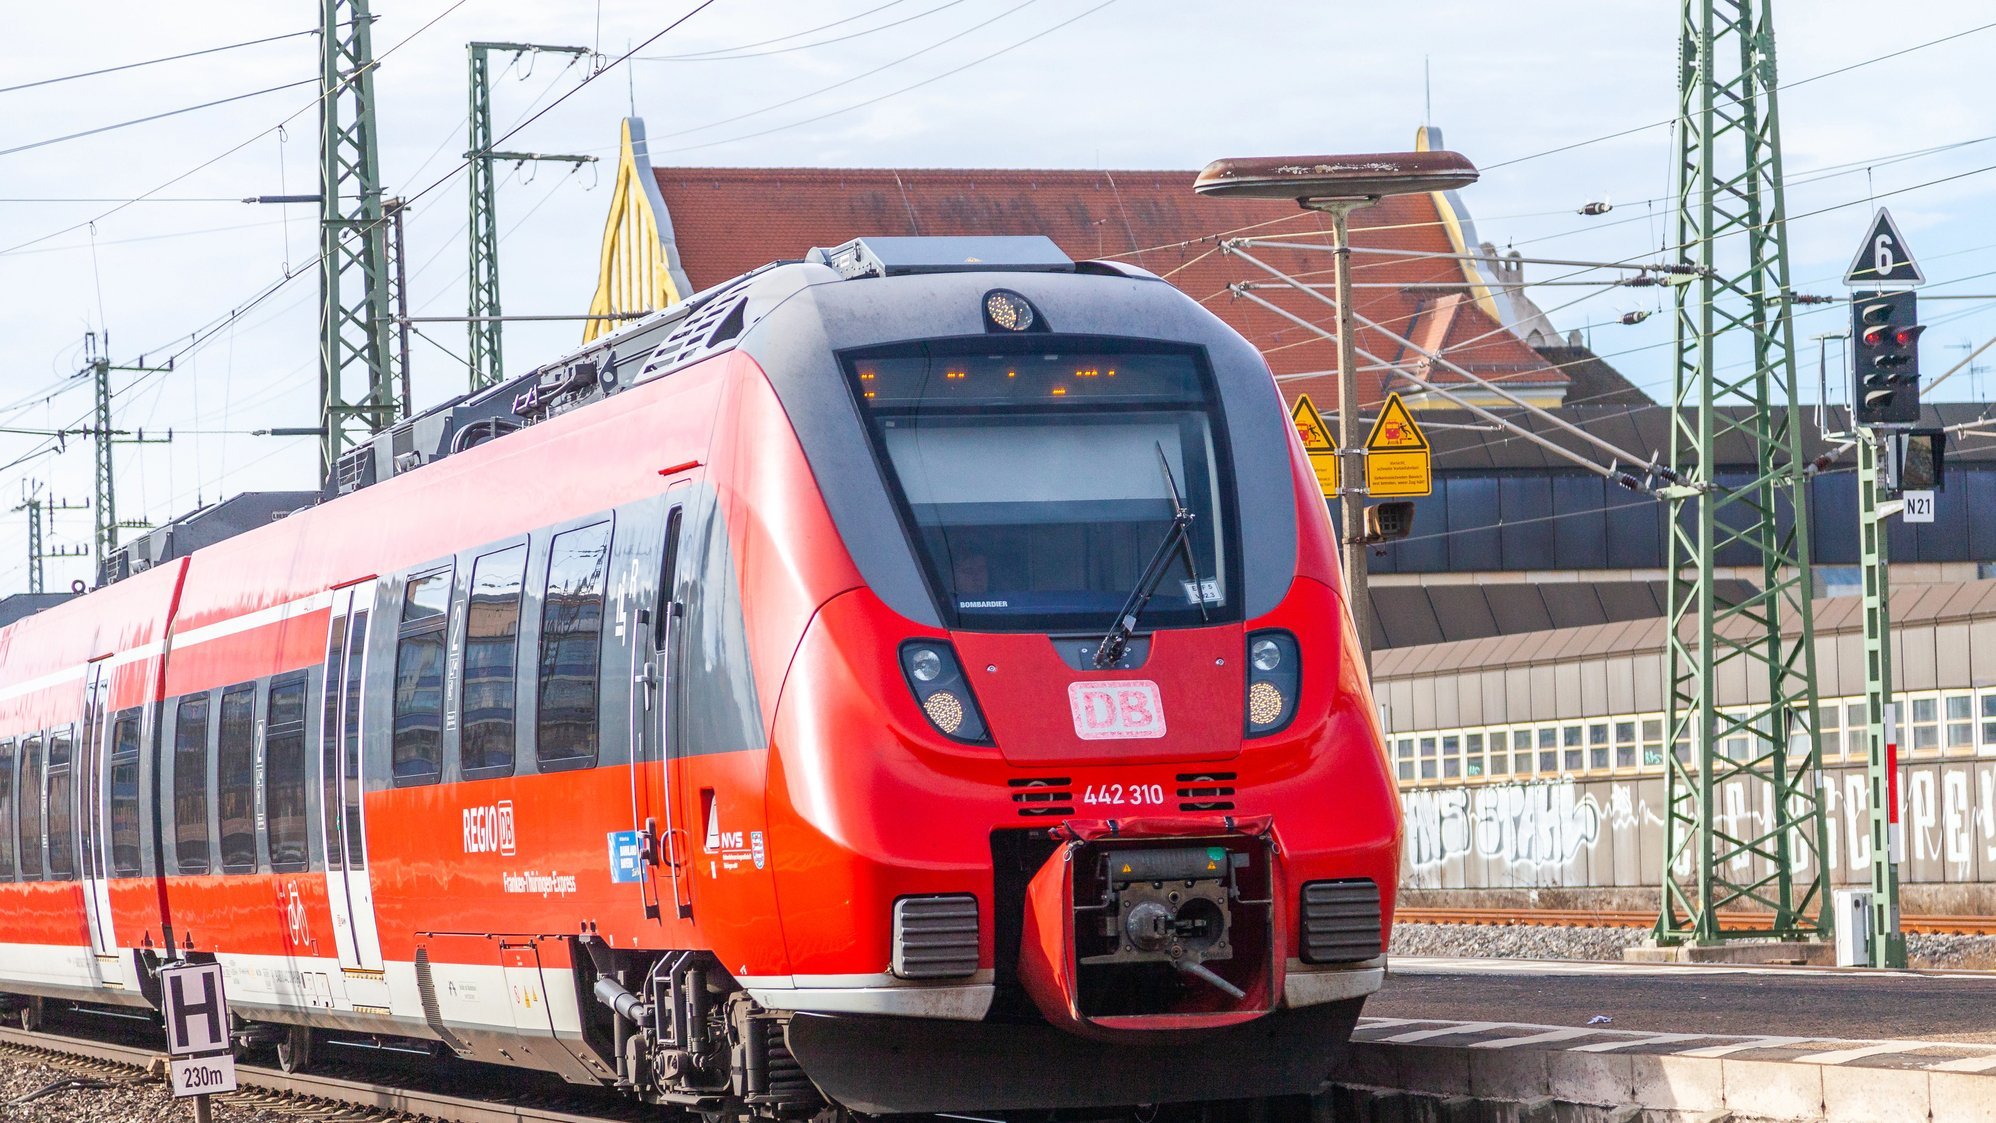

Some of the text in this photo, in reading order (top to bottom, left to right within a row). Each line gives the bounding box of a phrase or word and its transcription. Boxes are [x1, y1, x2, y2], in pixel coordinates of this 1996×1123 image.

[1875, 234, 1893, 275] 6
[1907, 498, 1930, 515] N21
[960, 600, 1008, 609] BOMBARDIER
[452, 605, 461, 651] 2
[1083, 691, 1153, 729] DB
[257, 724, 263, 763] 2
[1083, 784, 1164, 805] 442 310
[463, 805, 498, 853] REGIO
[721, 831, 743, 849] NVS
[169, 971, 222, 1048] H
[183, 1066, 223, 1088] 230m
